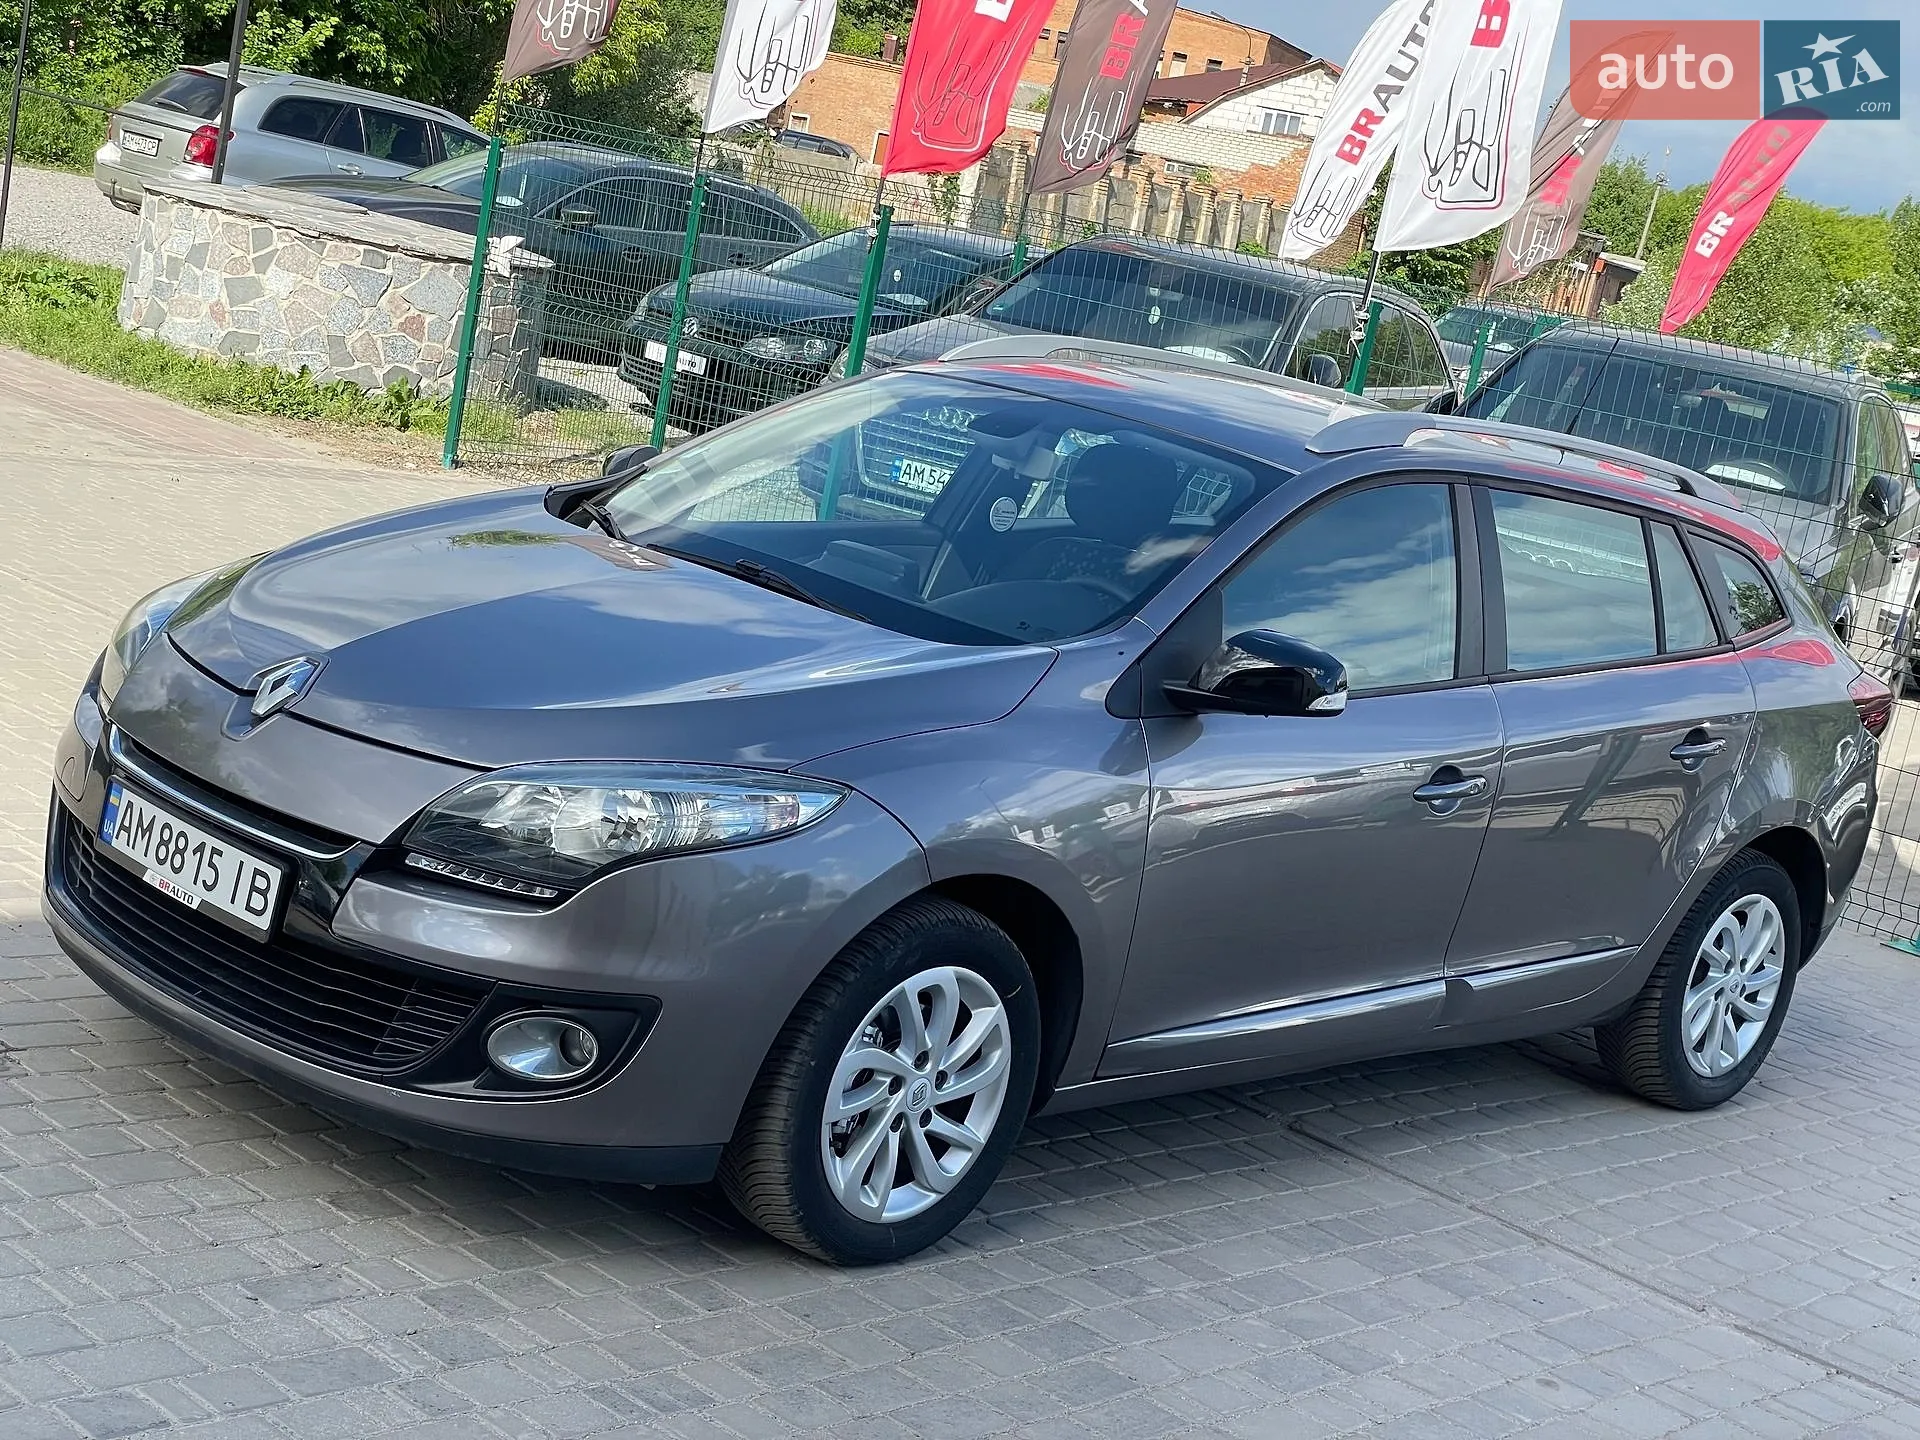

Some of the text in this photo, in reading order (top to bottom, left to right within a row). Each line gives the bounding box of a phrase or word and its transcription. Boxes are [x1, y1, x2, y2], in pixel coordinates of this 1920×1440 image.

[901, 463, 925, 484] AM
[103, 819, 115, 835] UA
[155, 822, 224, 892] 8815
[230, 860, 271, 916] IB
[158, 879, 194, 905] BRAUTO
